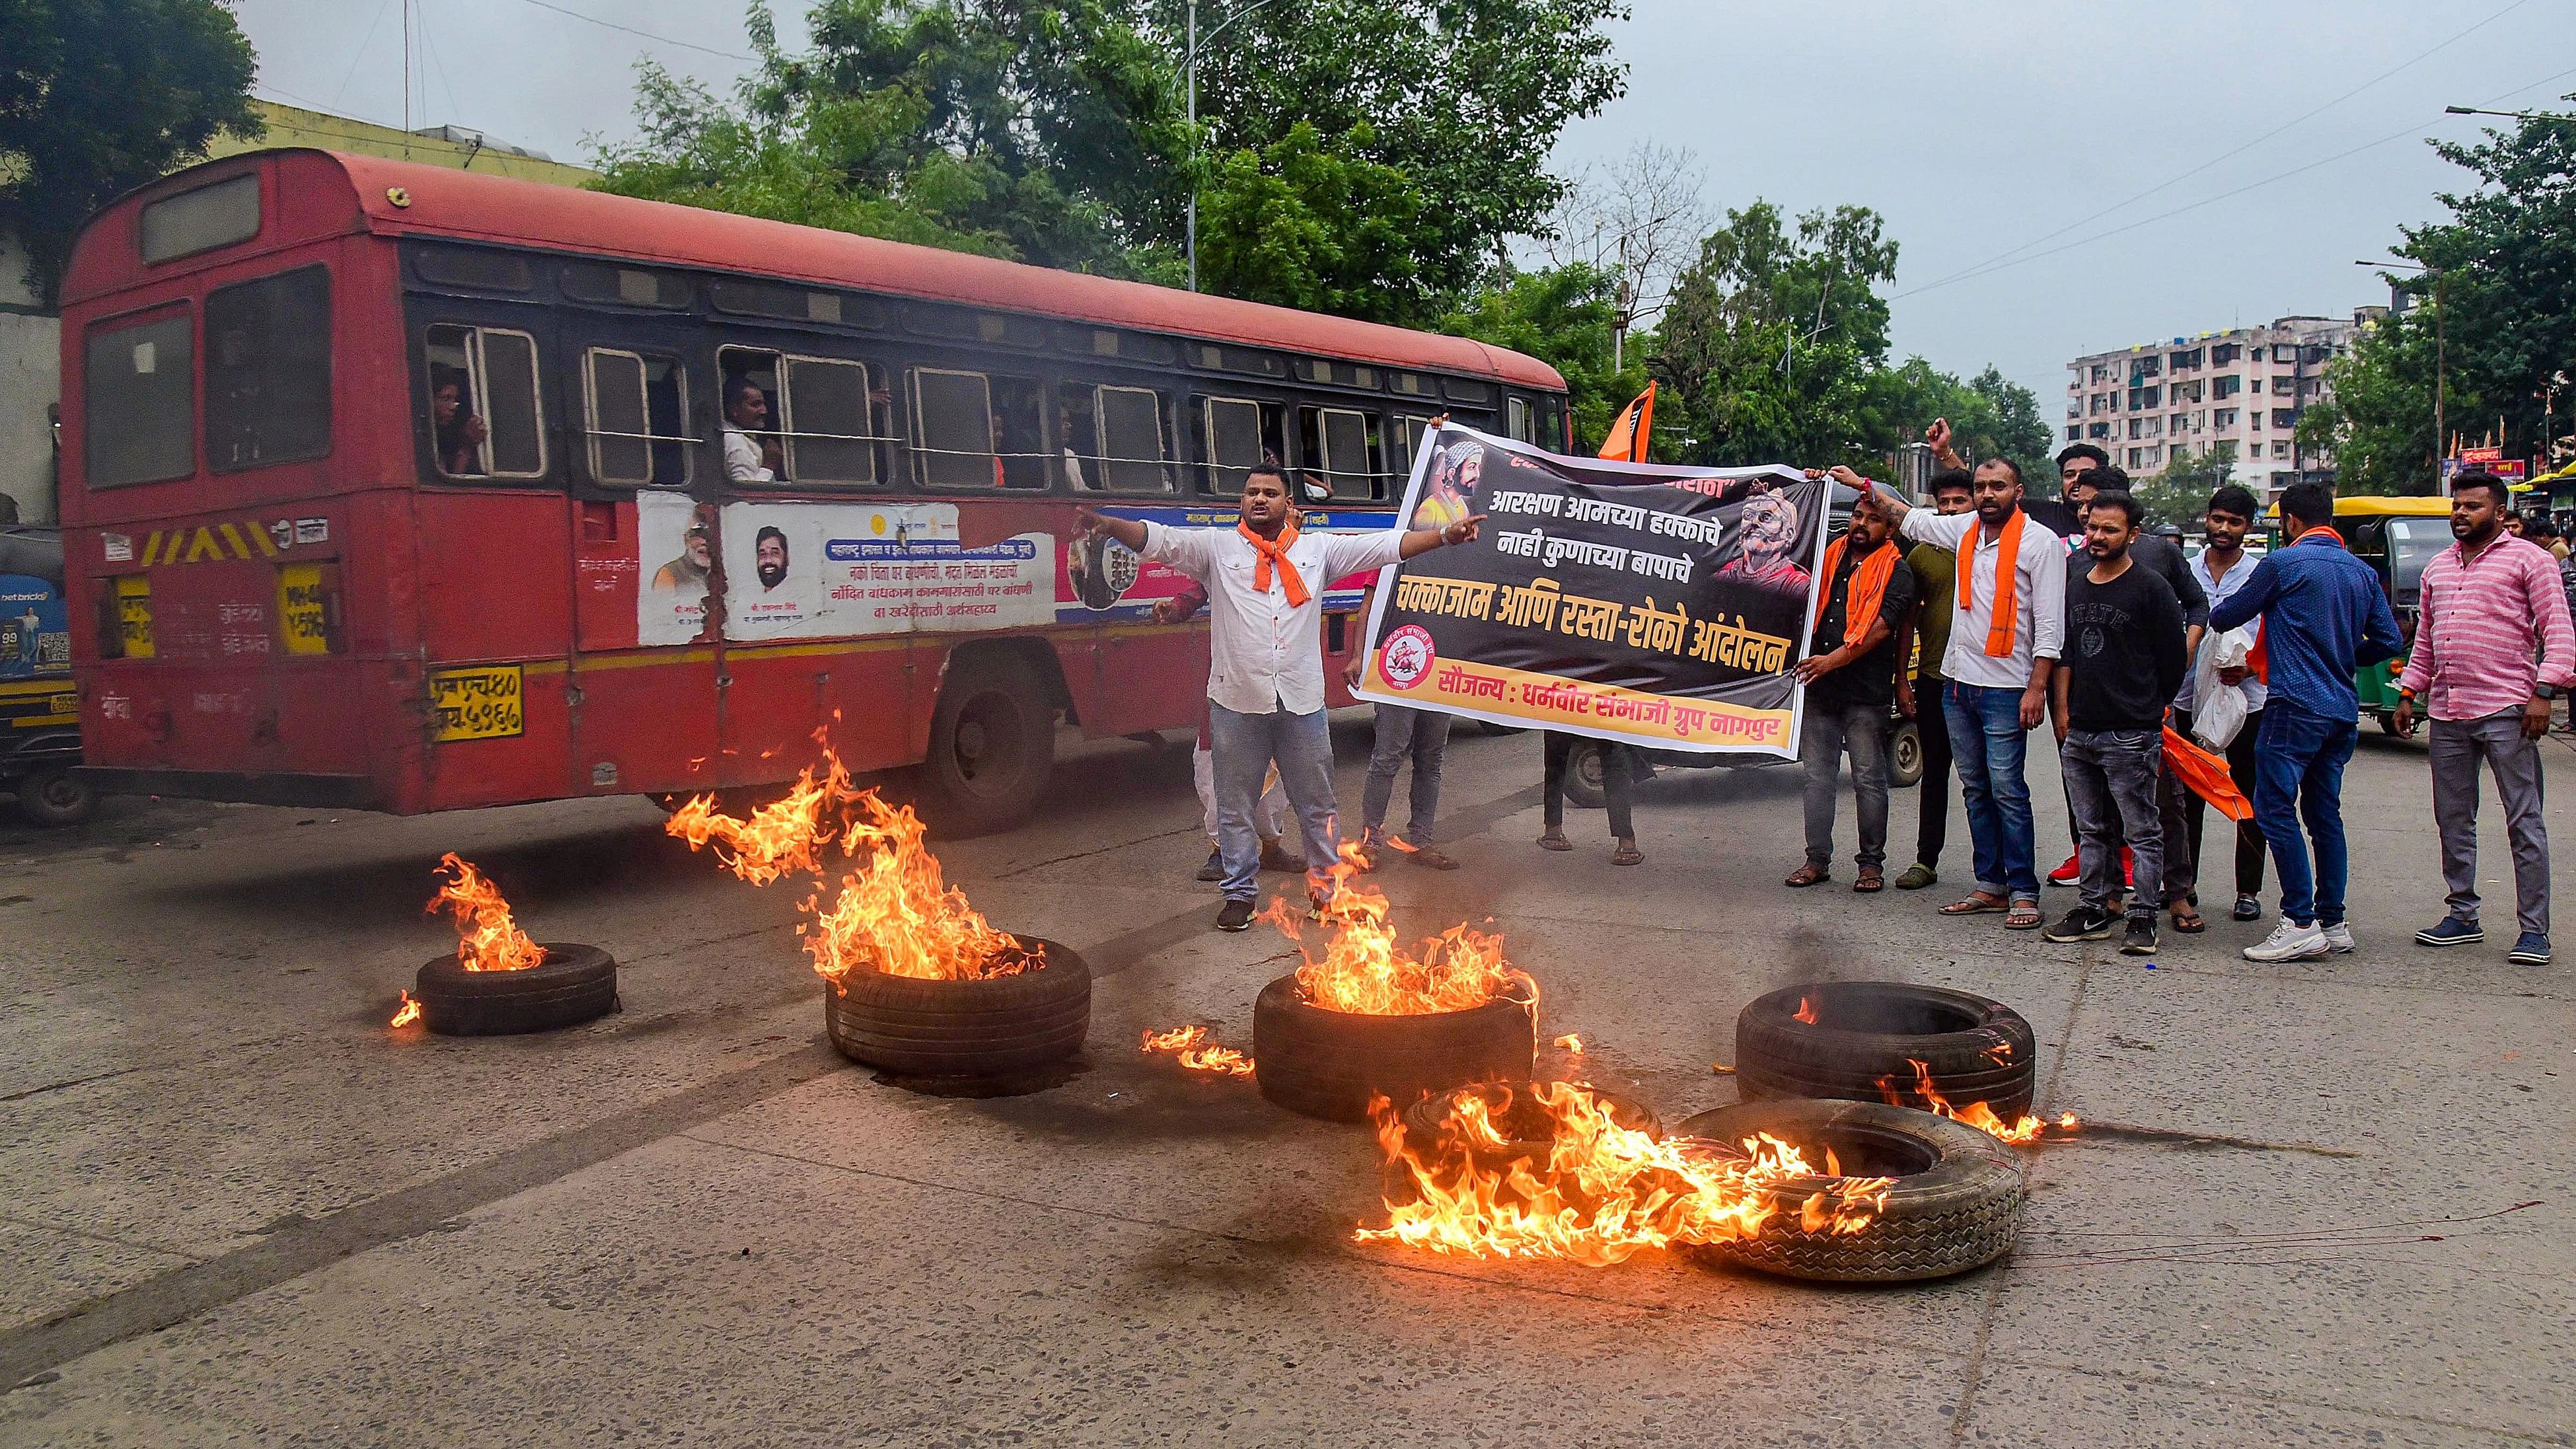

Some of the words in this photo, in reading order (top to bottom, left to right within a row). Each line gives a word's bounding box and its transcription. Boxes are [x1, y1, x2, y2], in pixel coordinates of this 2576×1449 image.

[1664, 478, 1736, 499] राठा”
[1489, 490, 1564, 517] आरक्षण
[1564, 496, 1647, 531] आमच्या
[1649, 509, 1724, 546] हक्काचे
[850, 562, 868, 581] नको
[1496, 527, 1546, 556] नाही
[1541, 537, 1629, 573] कुणाच्या
[1631, 549, 1695, 584] बापाचे
[889, 602, 943, 618] खरेदीसाठी
[946, 601, 997, 616] अर्थसहाय्य
[1396, 574, 1497, 621] चक्काजाम
[1495, 577, 1561, 632] आणि
[1560, 593, 1689, 655] रस्ता-रोको
[1688, 612, 1792, 676] आंदोलन
[1384, 630, 1404, 648] धर्मवीर
[1406, 626, 1429, 642] संभाजी
[1438, 665, 1506, 701] सौजन्य
[1522, 681, 1593, 714] धर्मवीर
[1595, 691, 1671, 725] संभाजी
[1674, 706, 1707, 736] ग्रुप
[1709, 712, 1782, 741] नागपुर
